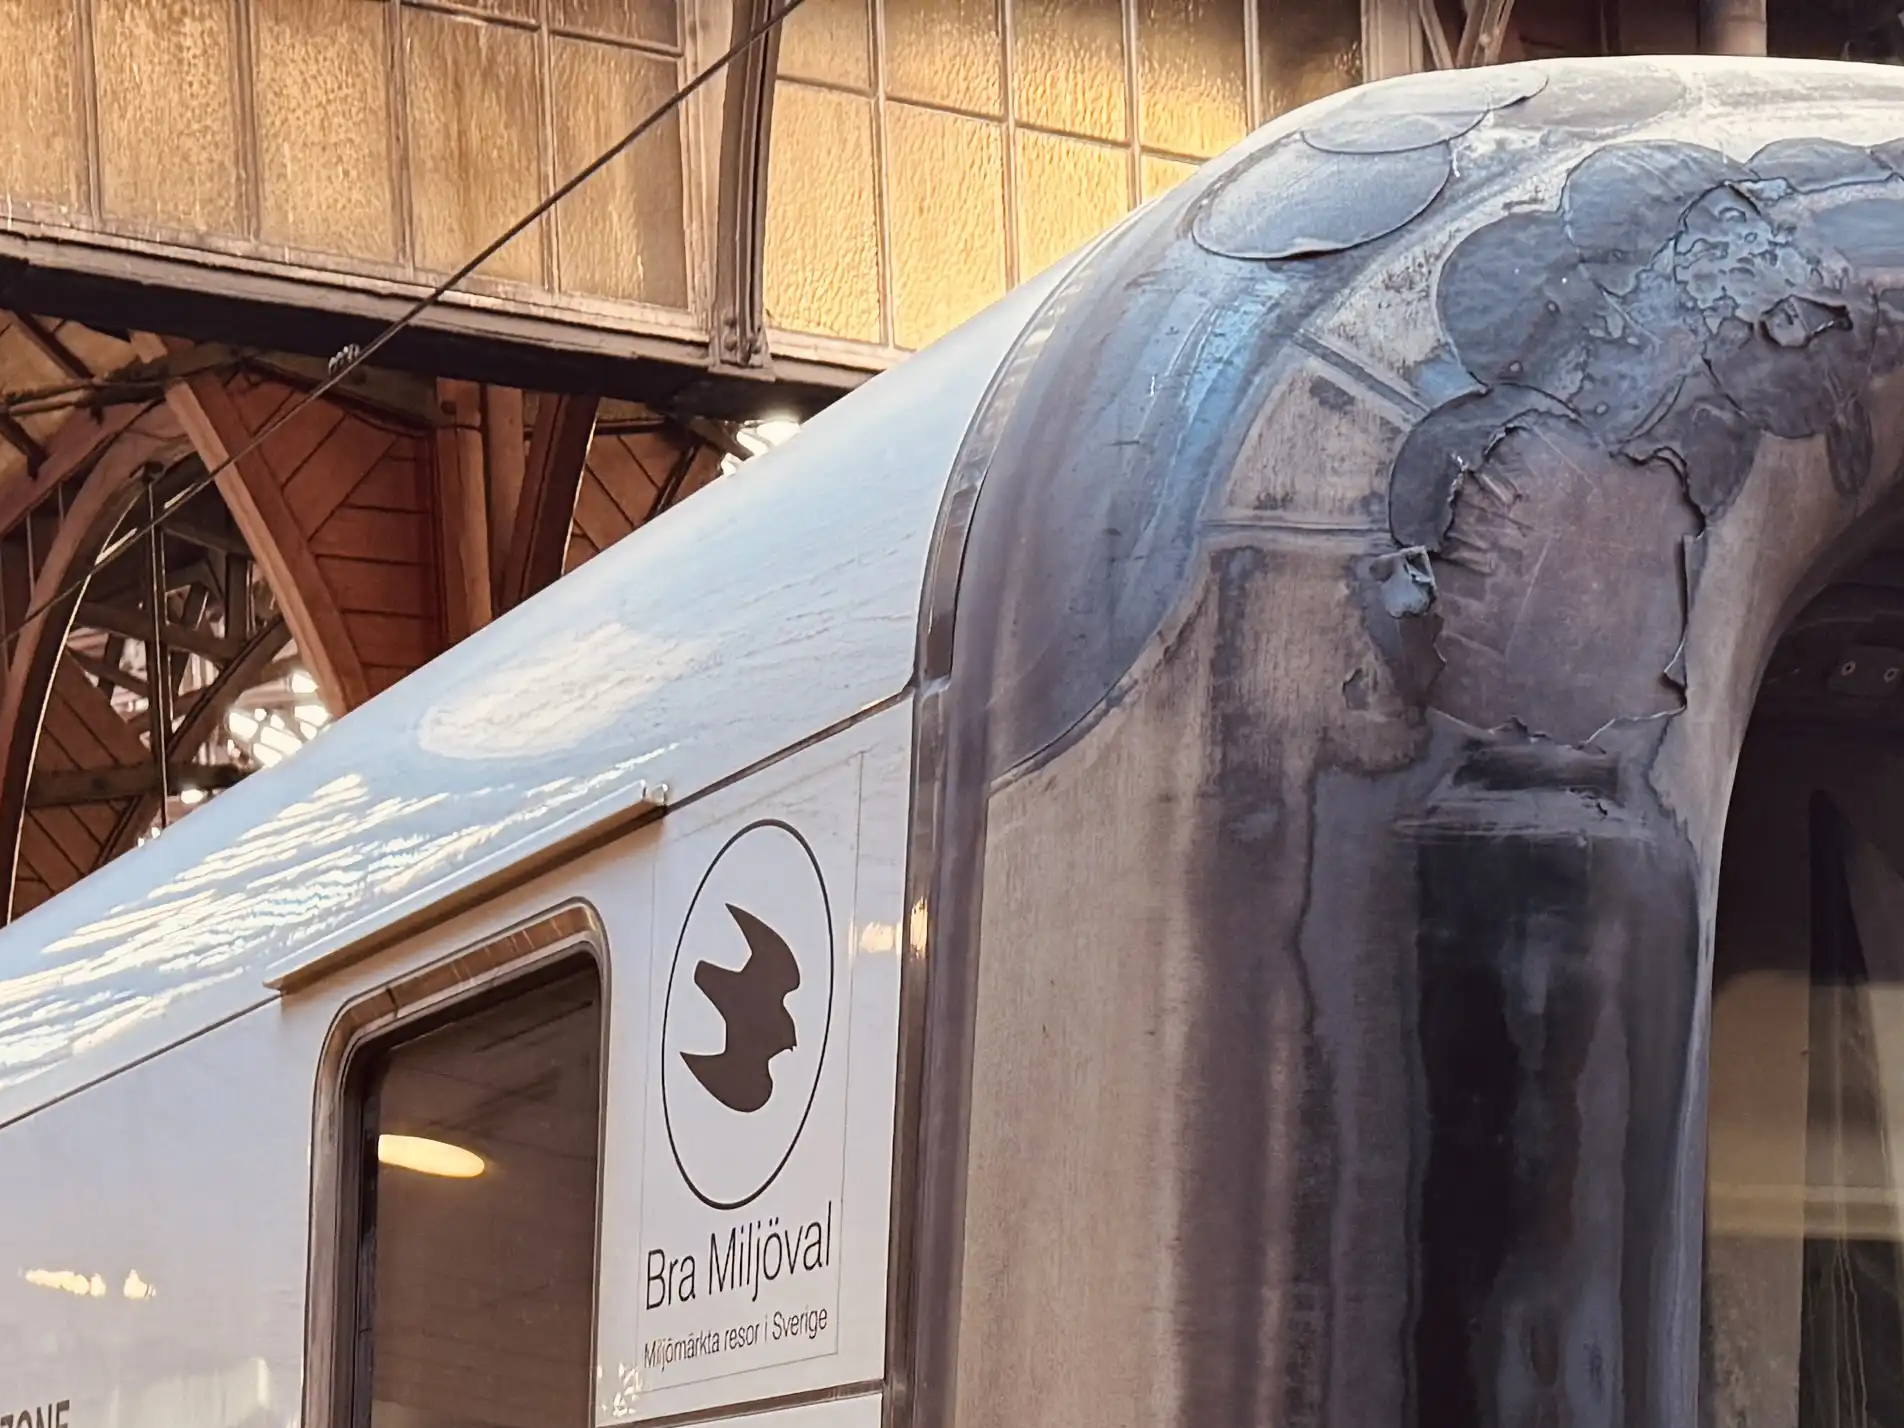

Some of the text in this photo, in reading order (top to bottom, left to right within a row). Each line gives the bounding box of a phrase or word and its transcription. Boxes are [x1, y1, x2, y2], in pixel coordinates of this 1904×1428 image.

[646, 1200, 832, 1311] Bra Miljöval
[643, 1329, 720, 1373] Miljömärkta
[723, 1322, 761, 1351] resor
[772, 1306, 828, 1340] Sverige
